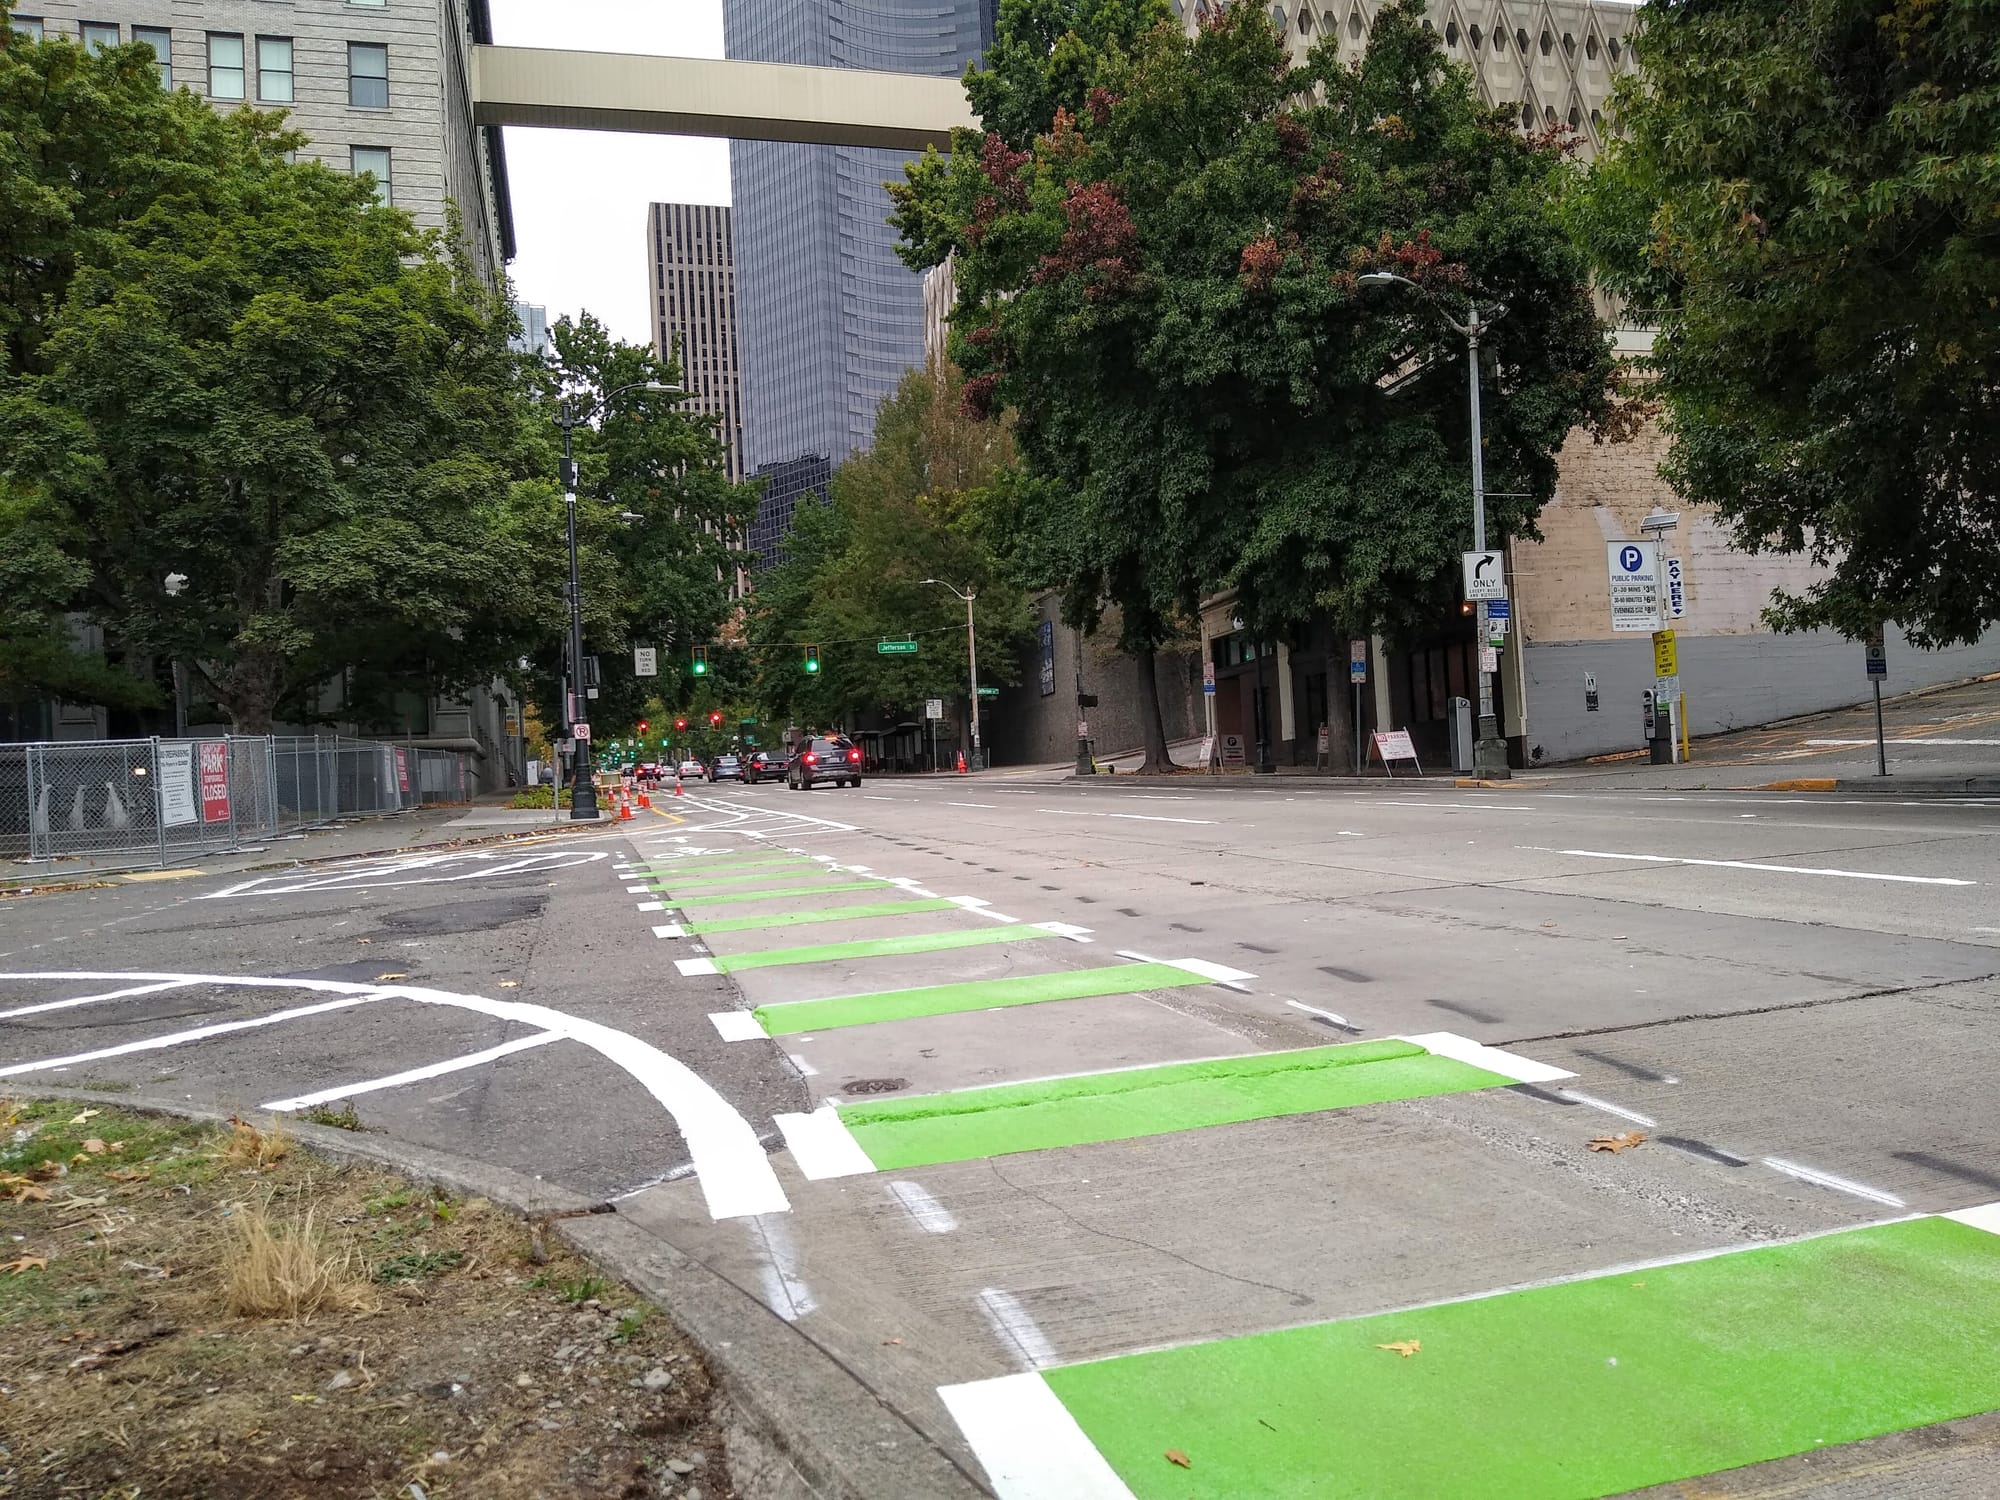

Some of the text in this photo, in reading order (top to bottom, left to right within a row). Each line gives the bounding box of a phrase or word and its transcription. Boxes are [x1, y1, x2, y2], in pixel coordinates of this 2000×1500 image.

[1626, 550, 1638, 568] P
[1631, 574, 1654, 582] PARKING
[1669, 560, 1680, 579] PAY
[1473, 579, 1496, 588] ONLY
[1670, 581, 1682, 607] HERE
[203, 753, 225, 773] PARK
[203, 784, 227, 801] CLOSED
